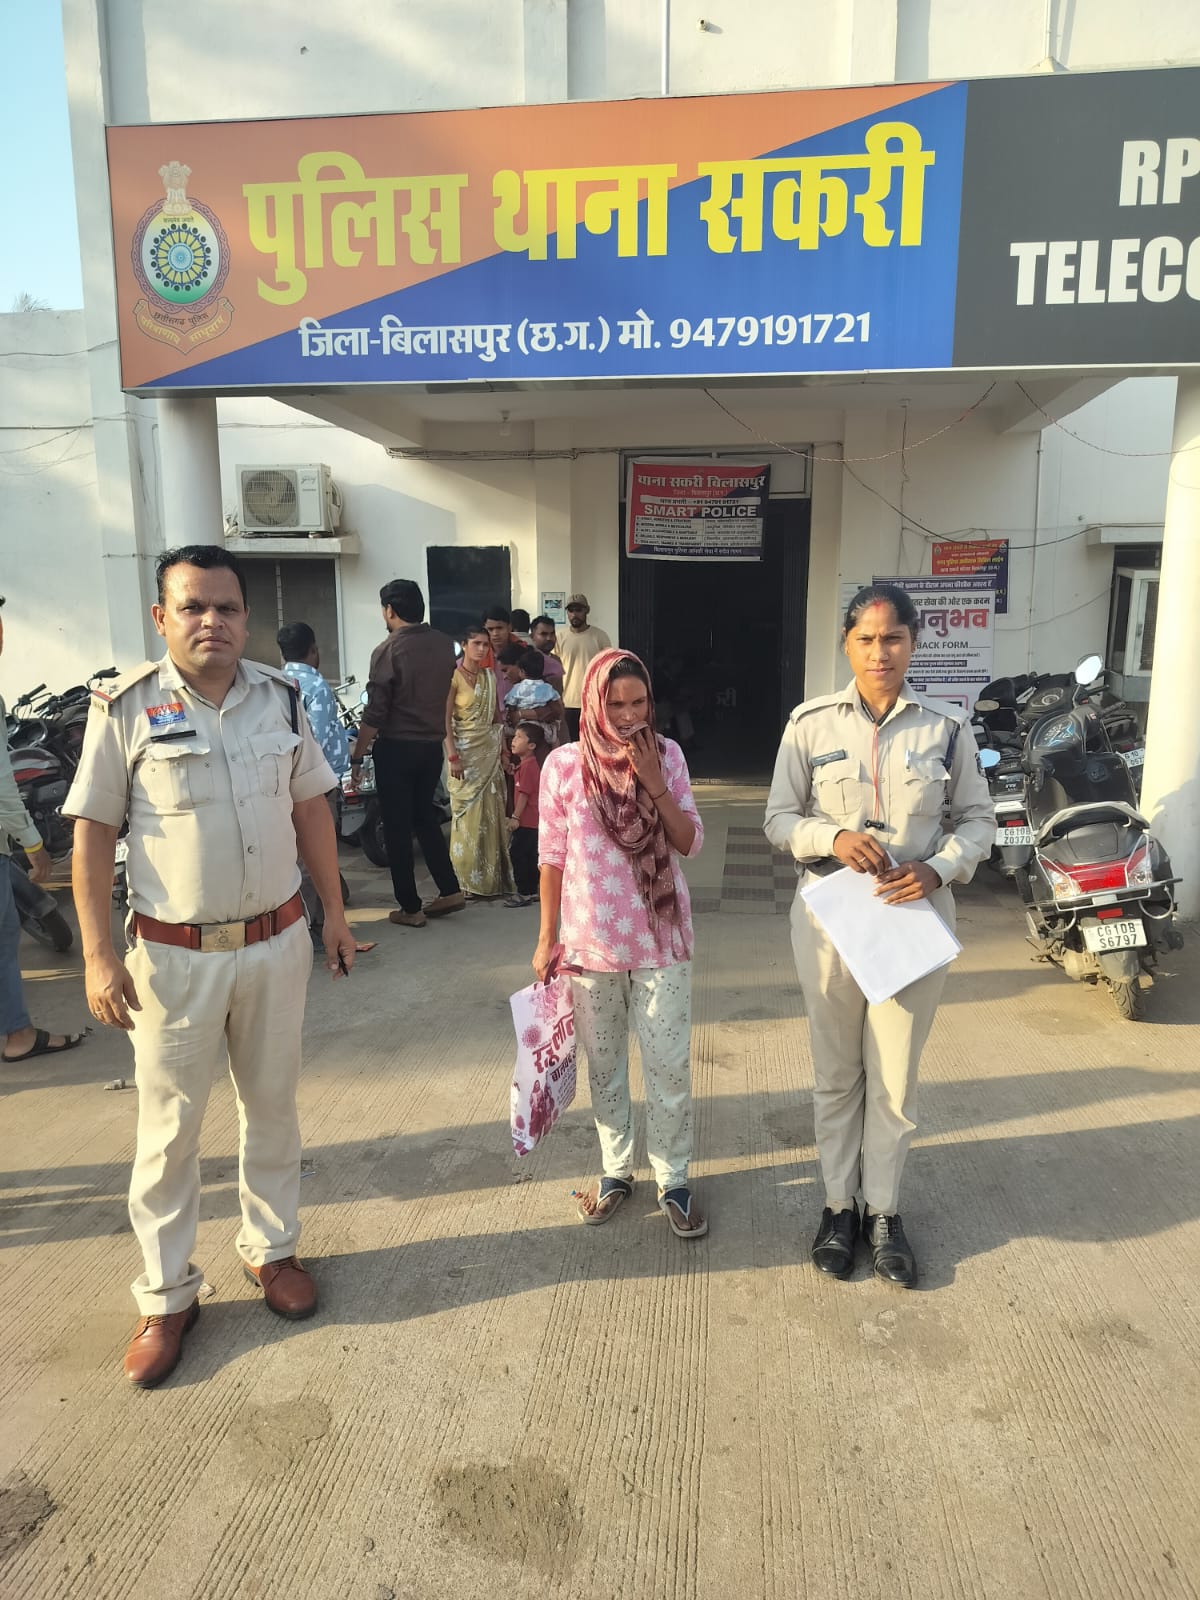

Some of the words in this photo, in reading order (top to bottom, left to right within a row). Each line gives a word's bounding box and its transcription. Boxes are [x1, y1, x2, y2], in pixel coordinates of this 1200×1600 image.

[242, 151, 468, 305] पुलिस
[493, 163, 677, 260] थाना
[698, 121, 935, 253] सकरी
[298, 314, 512, 362] जिला-बिलासपुर
[517, 316, 610, 355] (छ.ग.)
[617, 308, 661, 349] मो.
[669, 312, 870, 348] 9479191721
[670, 474, 704, 488] सकरी
[707, 475, 766, 490] बिलासपुर
[644, 504, 697, 517] SMART
[701, 506, 757, 518] POLICE
[938, 596, 947, 606] की
[916, 641, 939, 649] BACK
[942, 641, 969, 649] FORM
[1097, 922, 1136, 938] CG10B
[1099, 934, 1137, 949] S6797
